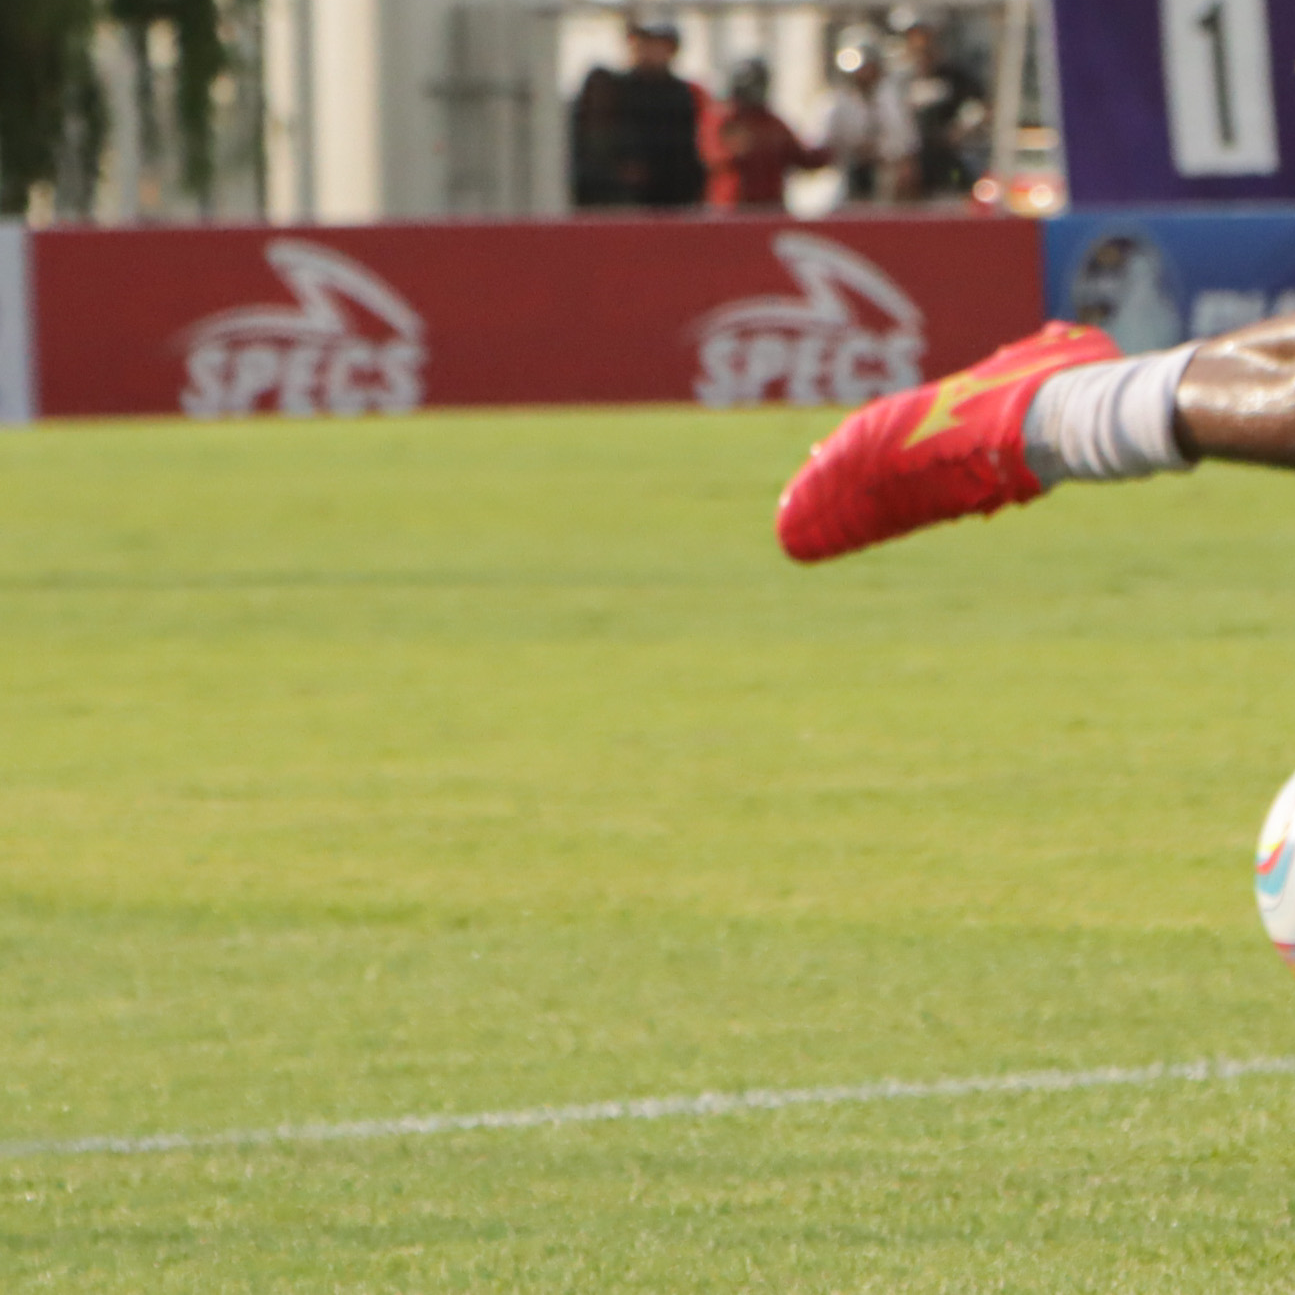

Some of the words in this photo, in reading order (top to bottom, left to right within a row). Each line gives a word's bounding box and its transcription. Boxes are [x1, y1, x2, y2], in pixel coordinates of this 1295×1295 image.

[1196, 0, 1239, 151] 1
[180, 345, 425, 422] SPECS
[694, 335, 928, 409] SPECS
